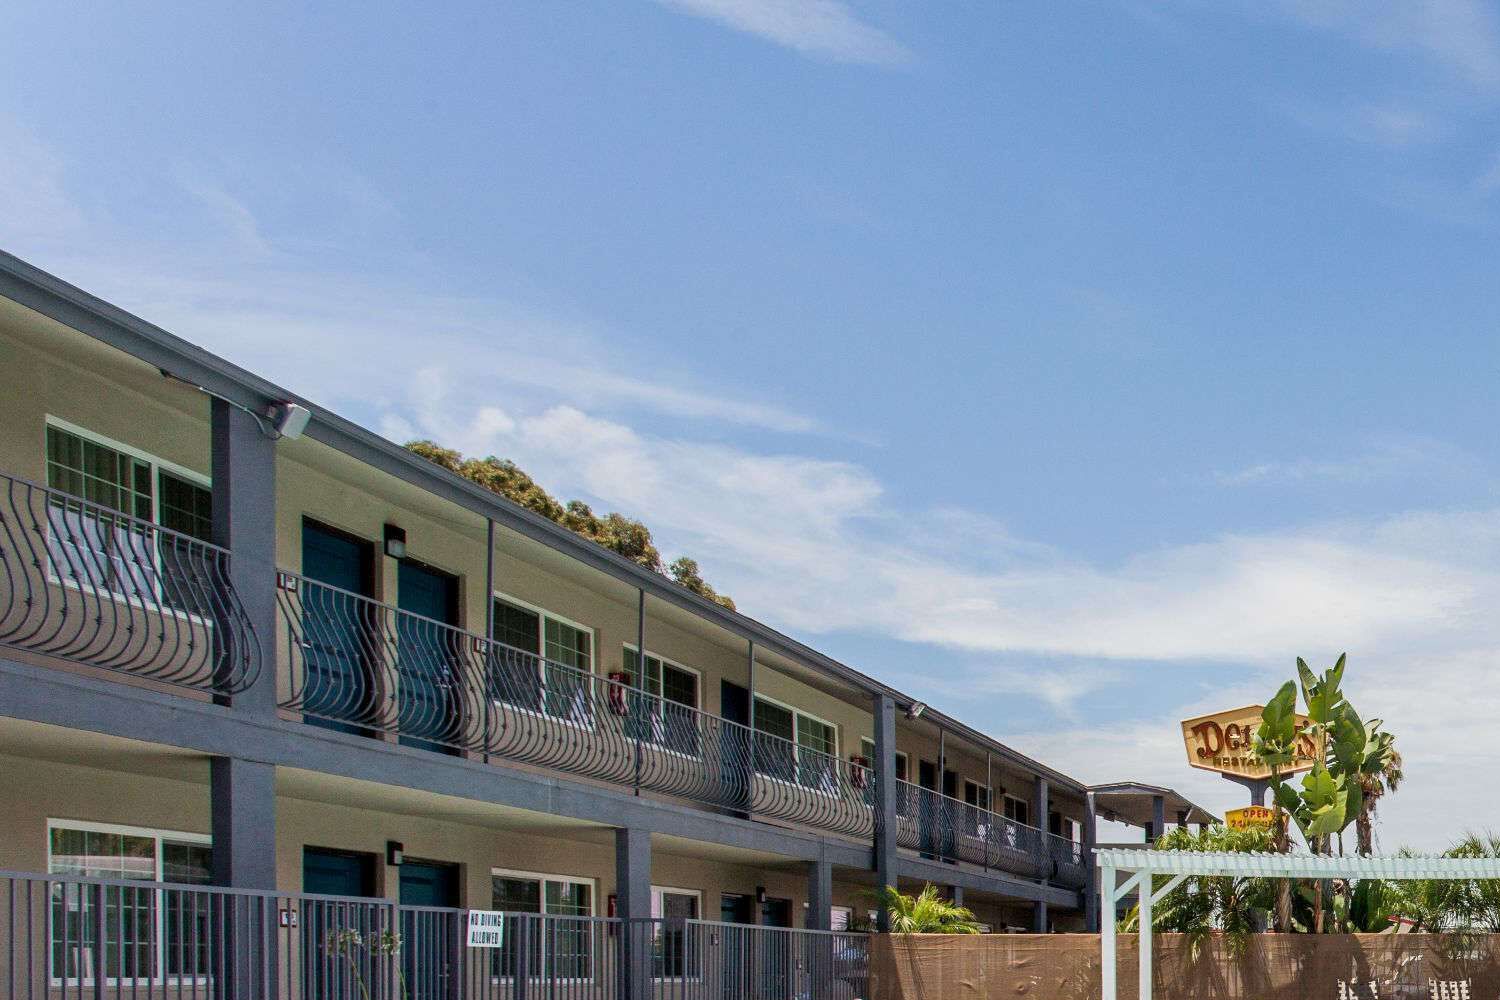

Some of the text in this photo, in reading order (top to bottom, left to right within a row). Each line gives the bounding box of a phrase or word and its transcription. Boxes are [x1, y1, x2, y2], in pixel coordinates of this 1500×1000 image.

[1243, 809, 1269, 818] OPEN
[470, 913, 502, 927] NO DIVING
[471, 931, 499, 945] ALLOWED
